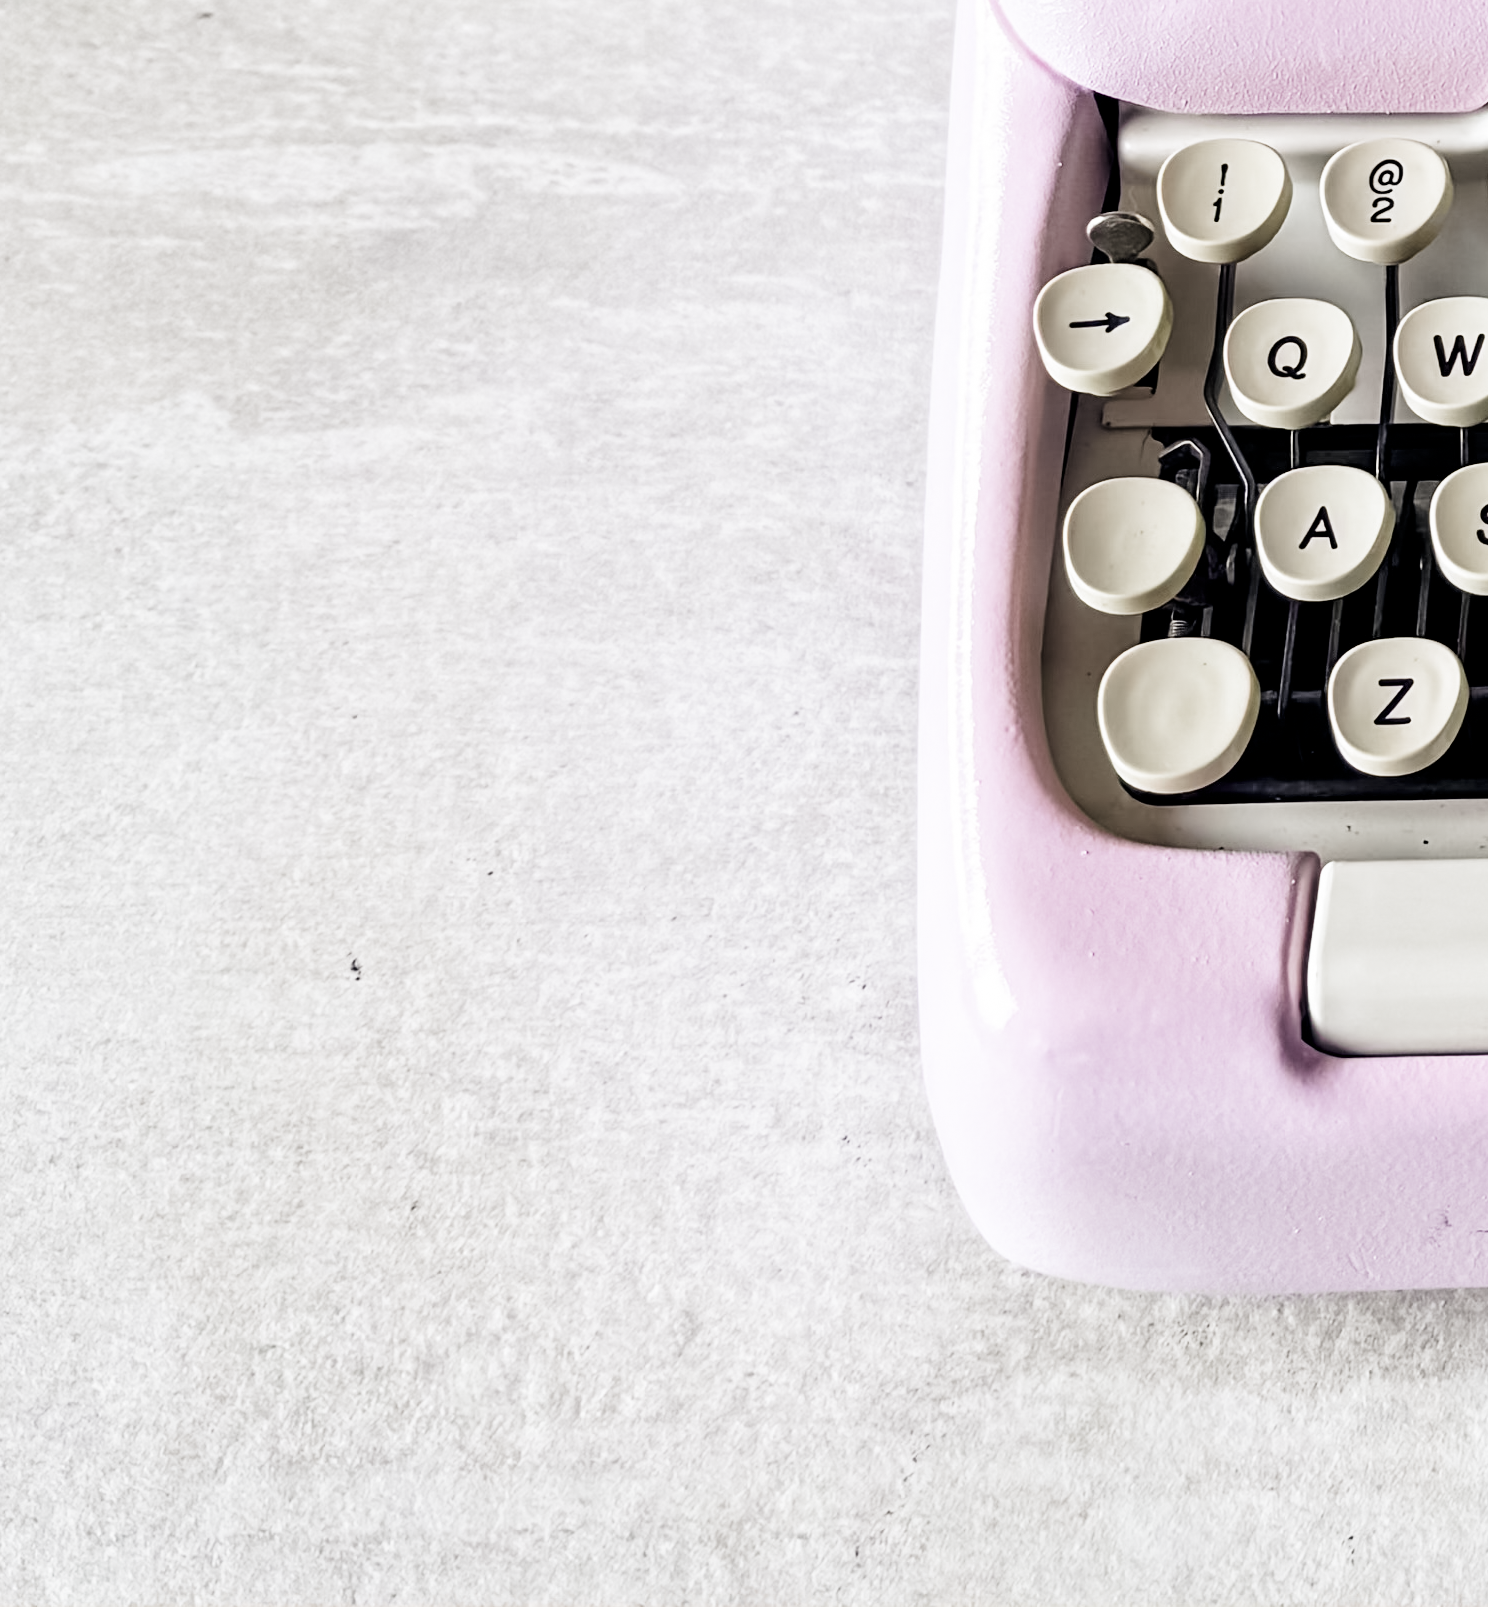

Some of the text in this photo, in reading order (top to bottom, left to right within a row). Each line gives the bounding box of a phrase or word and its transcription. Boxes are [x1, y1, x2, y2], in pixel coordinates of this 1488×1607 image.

[1368, 159, 1404, 194] @
[1212, 197, 1223, 223] 1
[1370, 196, 1395, 223] 2
[1267, 335, 1308, 380] Q
[1433, 333, 1485, 378] W
[1298, 505, 1338, 550] A
[1373, 678, 1414, 726] Z
